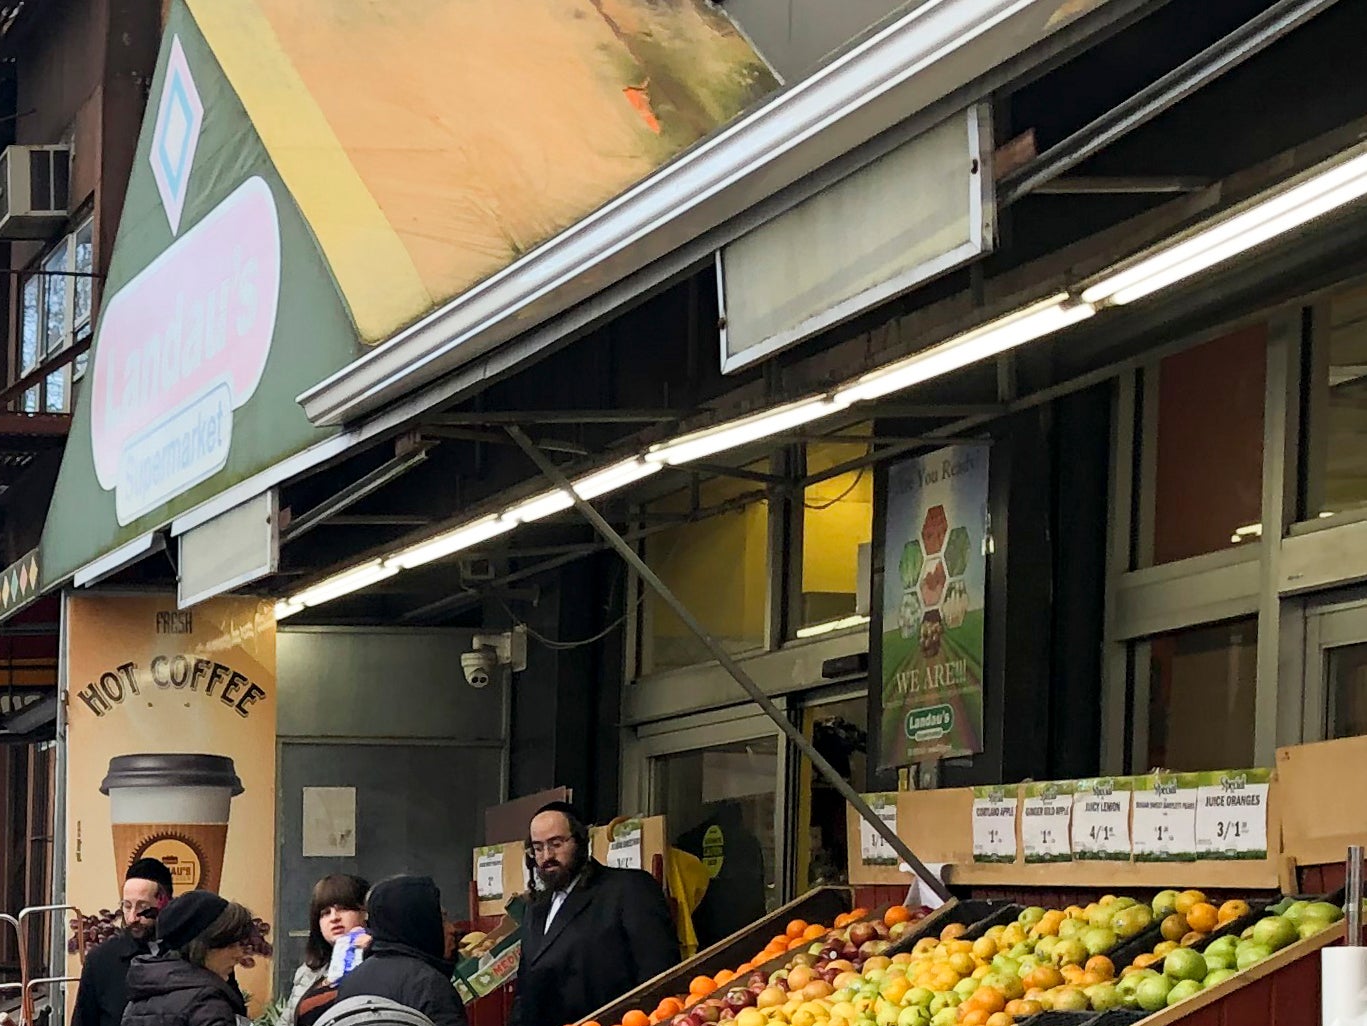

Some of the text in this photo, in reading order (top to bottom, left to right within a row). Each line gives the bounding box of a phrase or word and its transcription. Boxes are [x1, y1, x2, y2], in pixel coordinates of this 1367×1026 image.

[104, 246, 259, 431] Landau's
[124, 400, 224, 498] Supermarket
[156, 611, 193, 634] FRESH
[77, 654, 267, 719] HOT COFFEE
[896, 669, 920, 694] WE
[909, 709, 951, 730] Landau's
[1205, 794, 1261, 808] JUICE ORANGES
